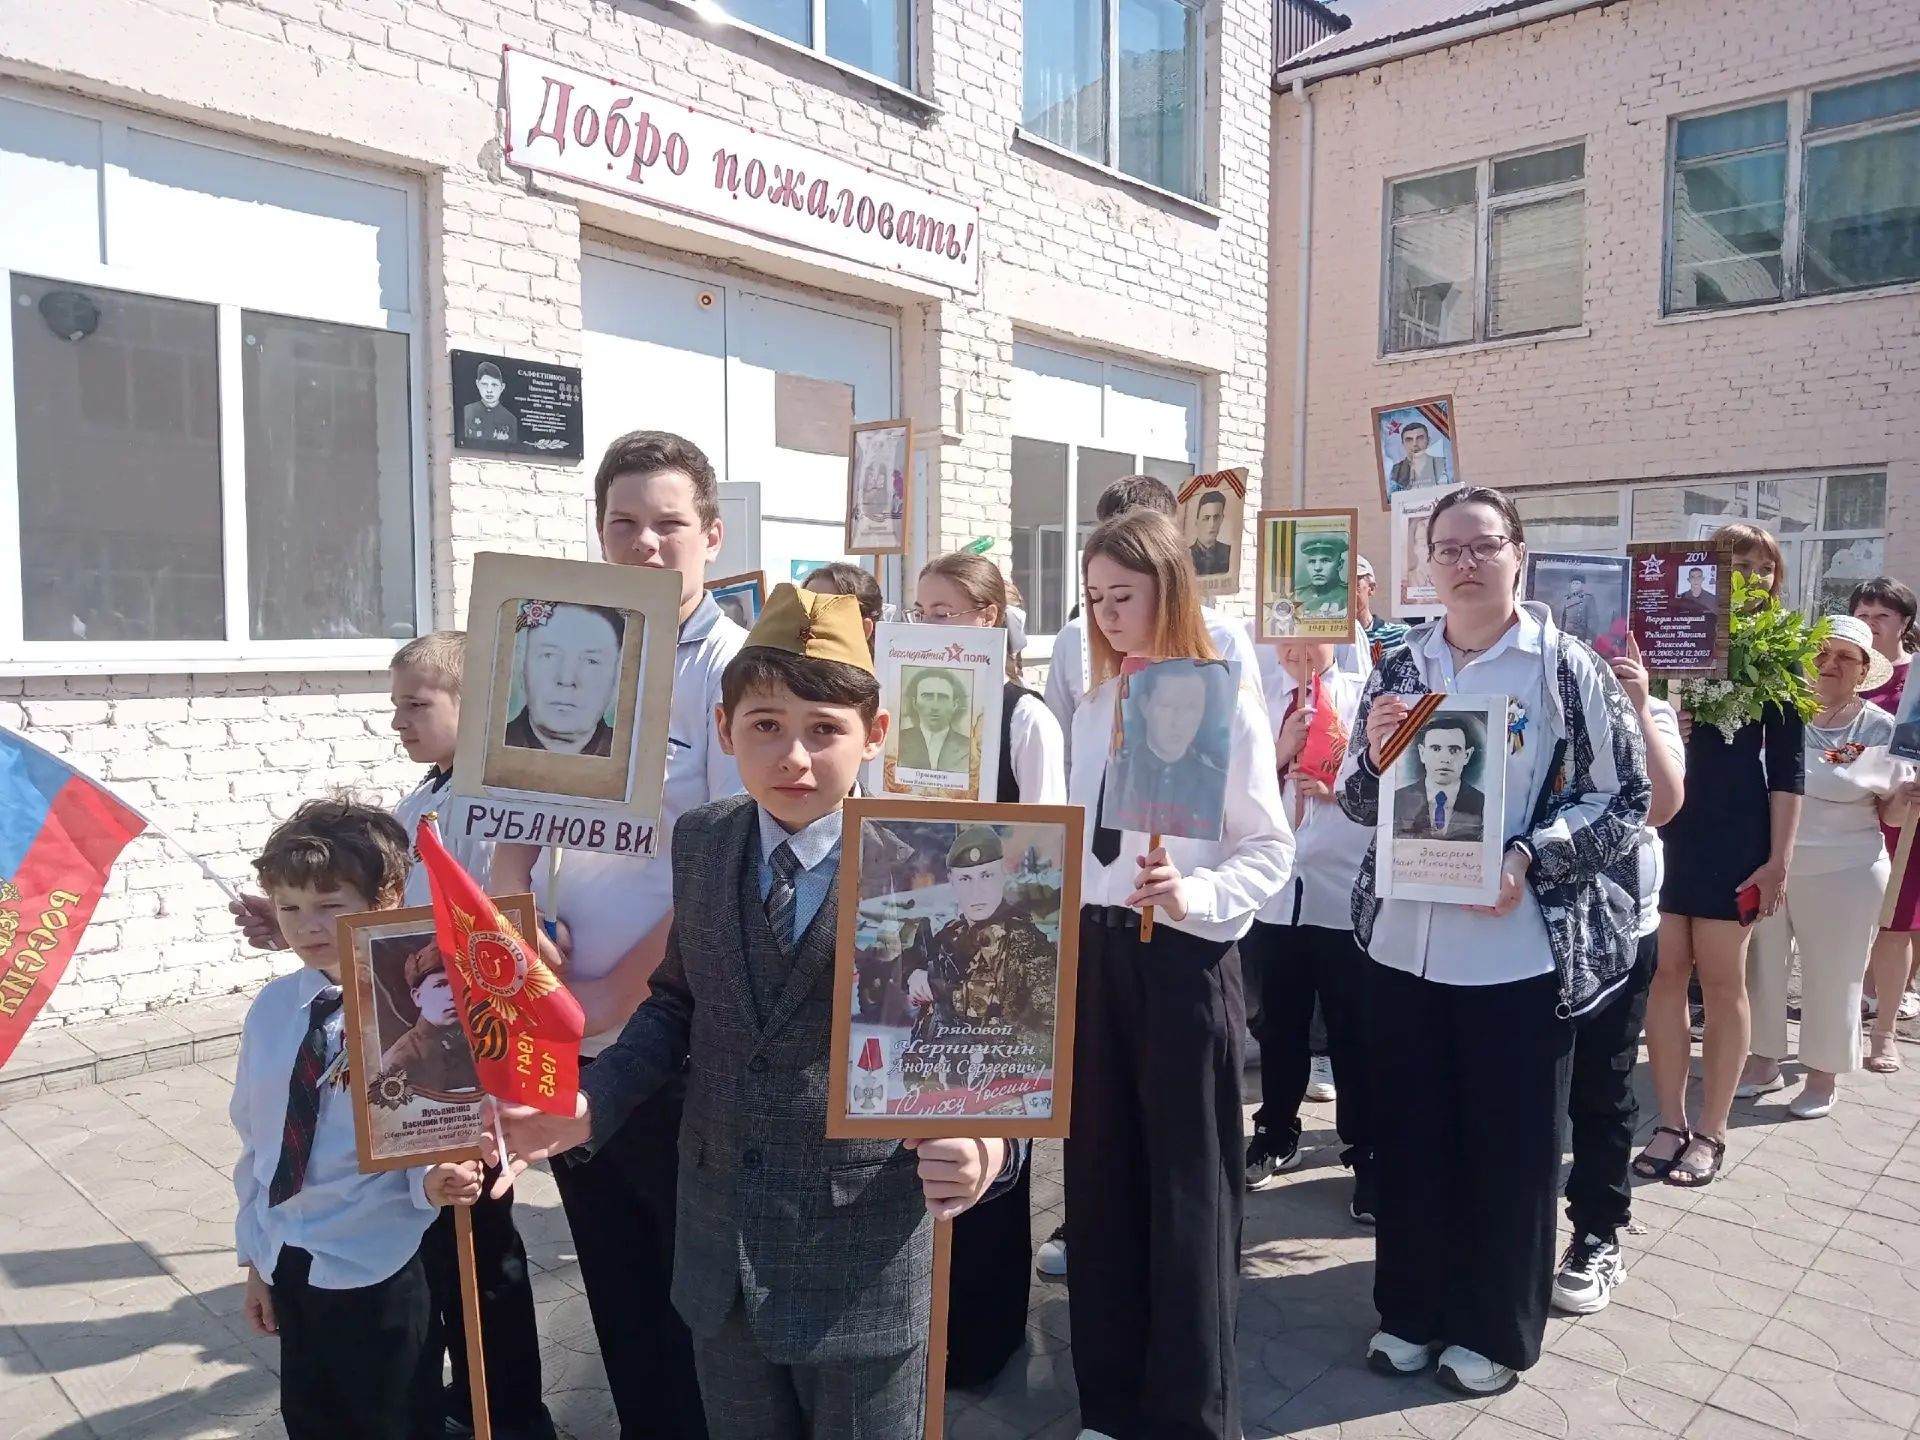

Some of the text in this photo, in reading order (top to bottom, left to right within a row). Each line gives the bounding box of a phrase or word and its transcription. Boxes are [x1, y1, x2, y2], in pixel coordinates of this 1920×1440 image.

[527, 76, 975, 264] Добро пожаловать!
[1685, 551, 1708, 563] ZOV
[466, 805, 652, 855] РУБАНОВ В.И.
[936, 1021, 1013, 1039] рядовой
[887, 1057, 1037, 1079] Андрей Сергеевич
[402, 1117, 438, 1129] Василий
